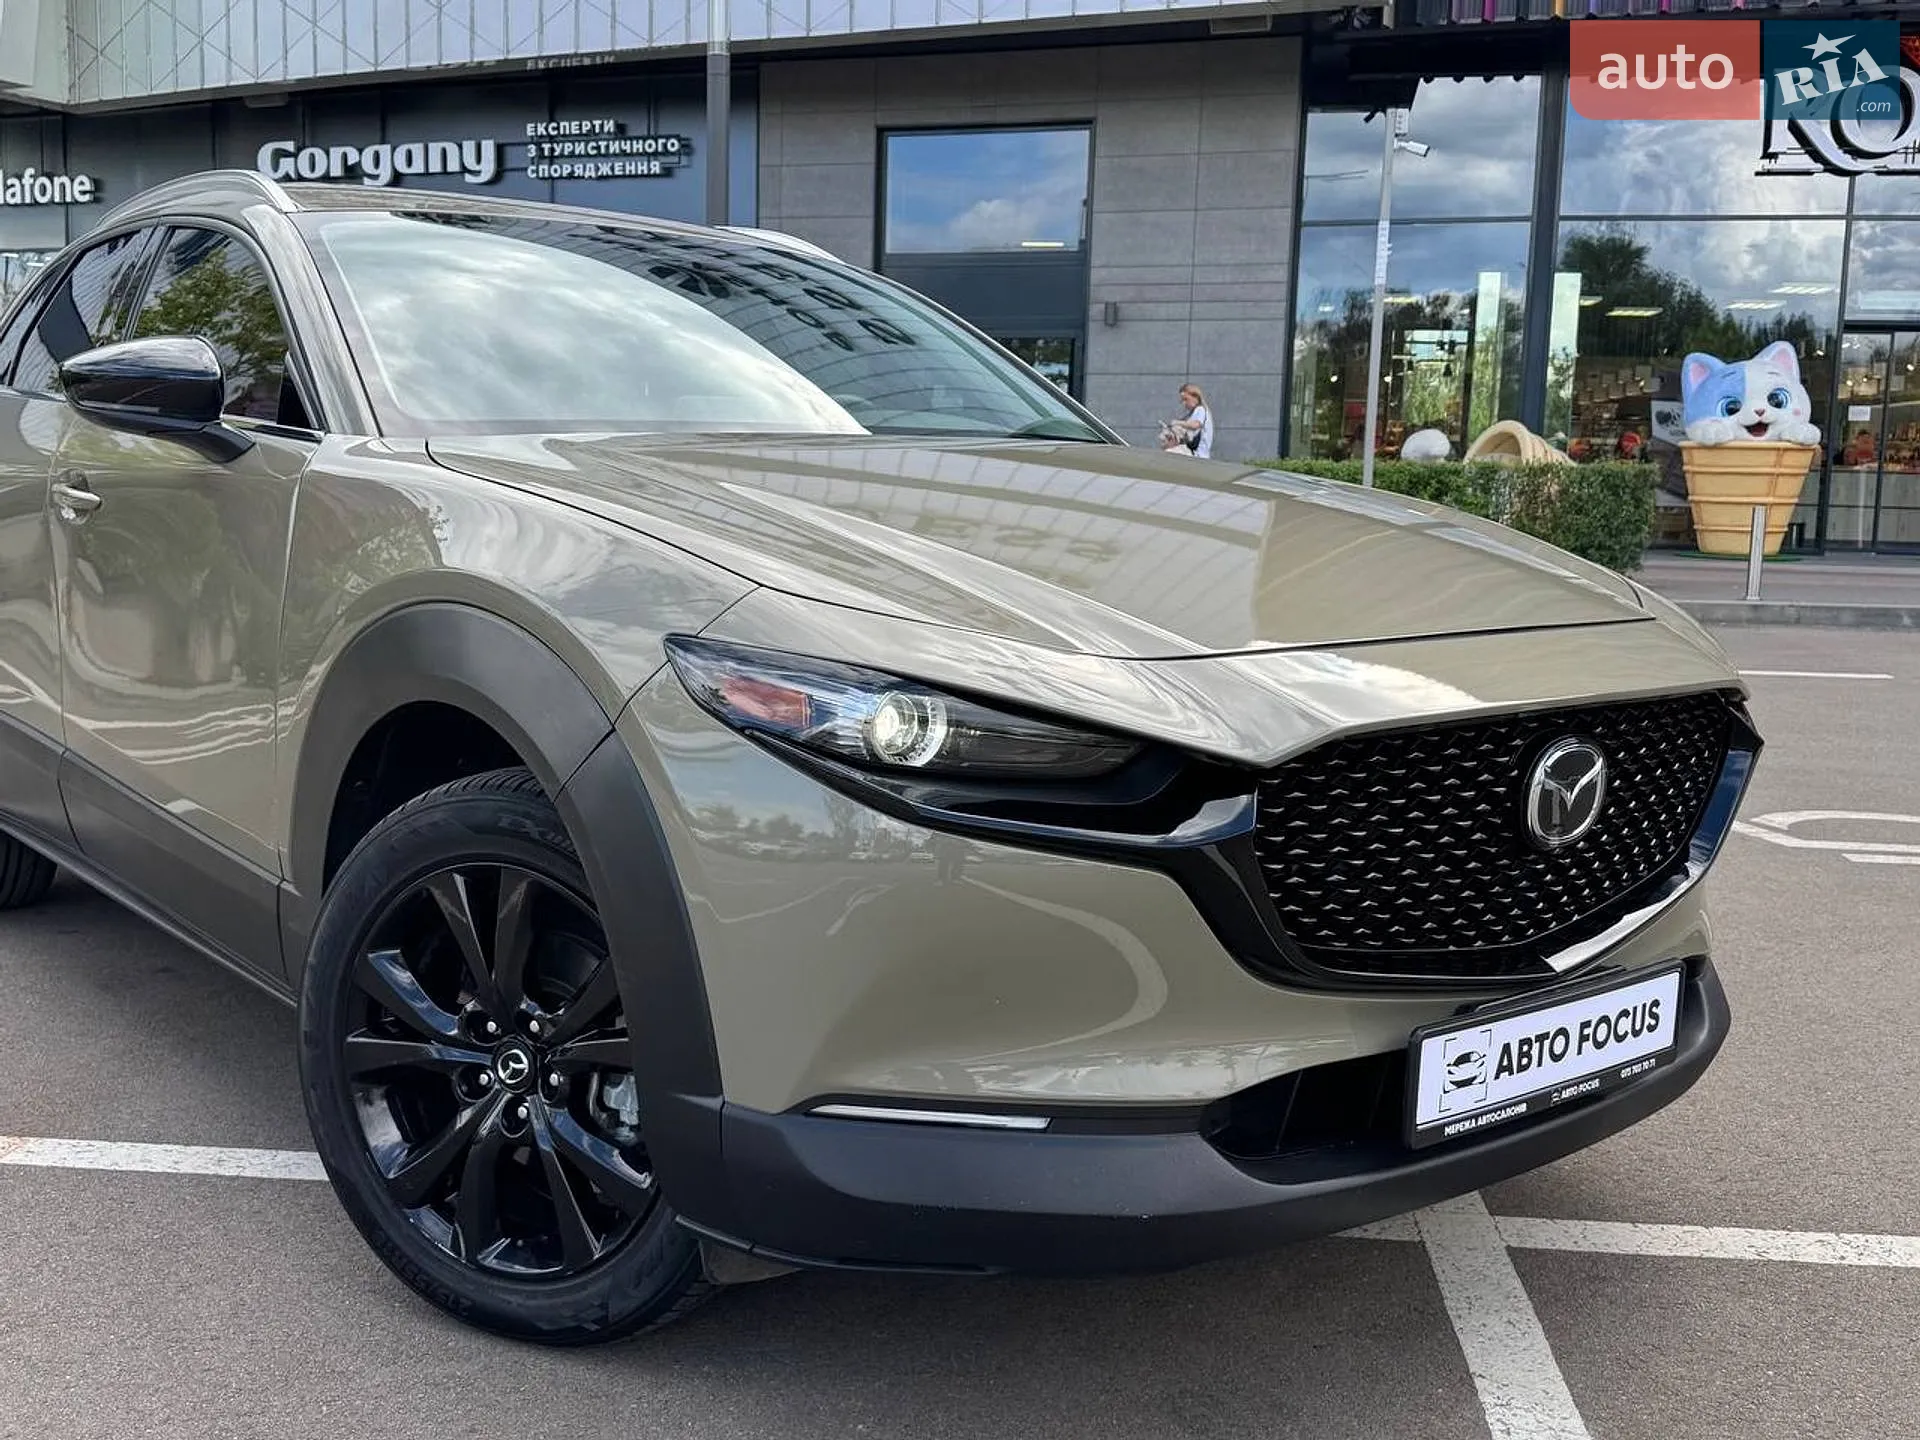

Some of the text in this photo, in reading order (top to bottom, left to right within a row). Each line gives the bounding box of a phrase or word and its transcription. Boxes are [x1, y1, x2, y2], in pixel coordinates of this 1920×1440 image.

[526, 120, 614, 136] ЕКСПЕРТИ
[541, 138, 680, 156] ТУРИСТИЧНОГО
[257, 139, 496, 186] Gorgany
[527, 160, 661, 178] СПОРЯДЖЕННЯ
[1494, 999, 1661, 1080] АВТО FOCUS
